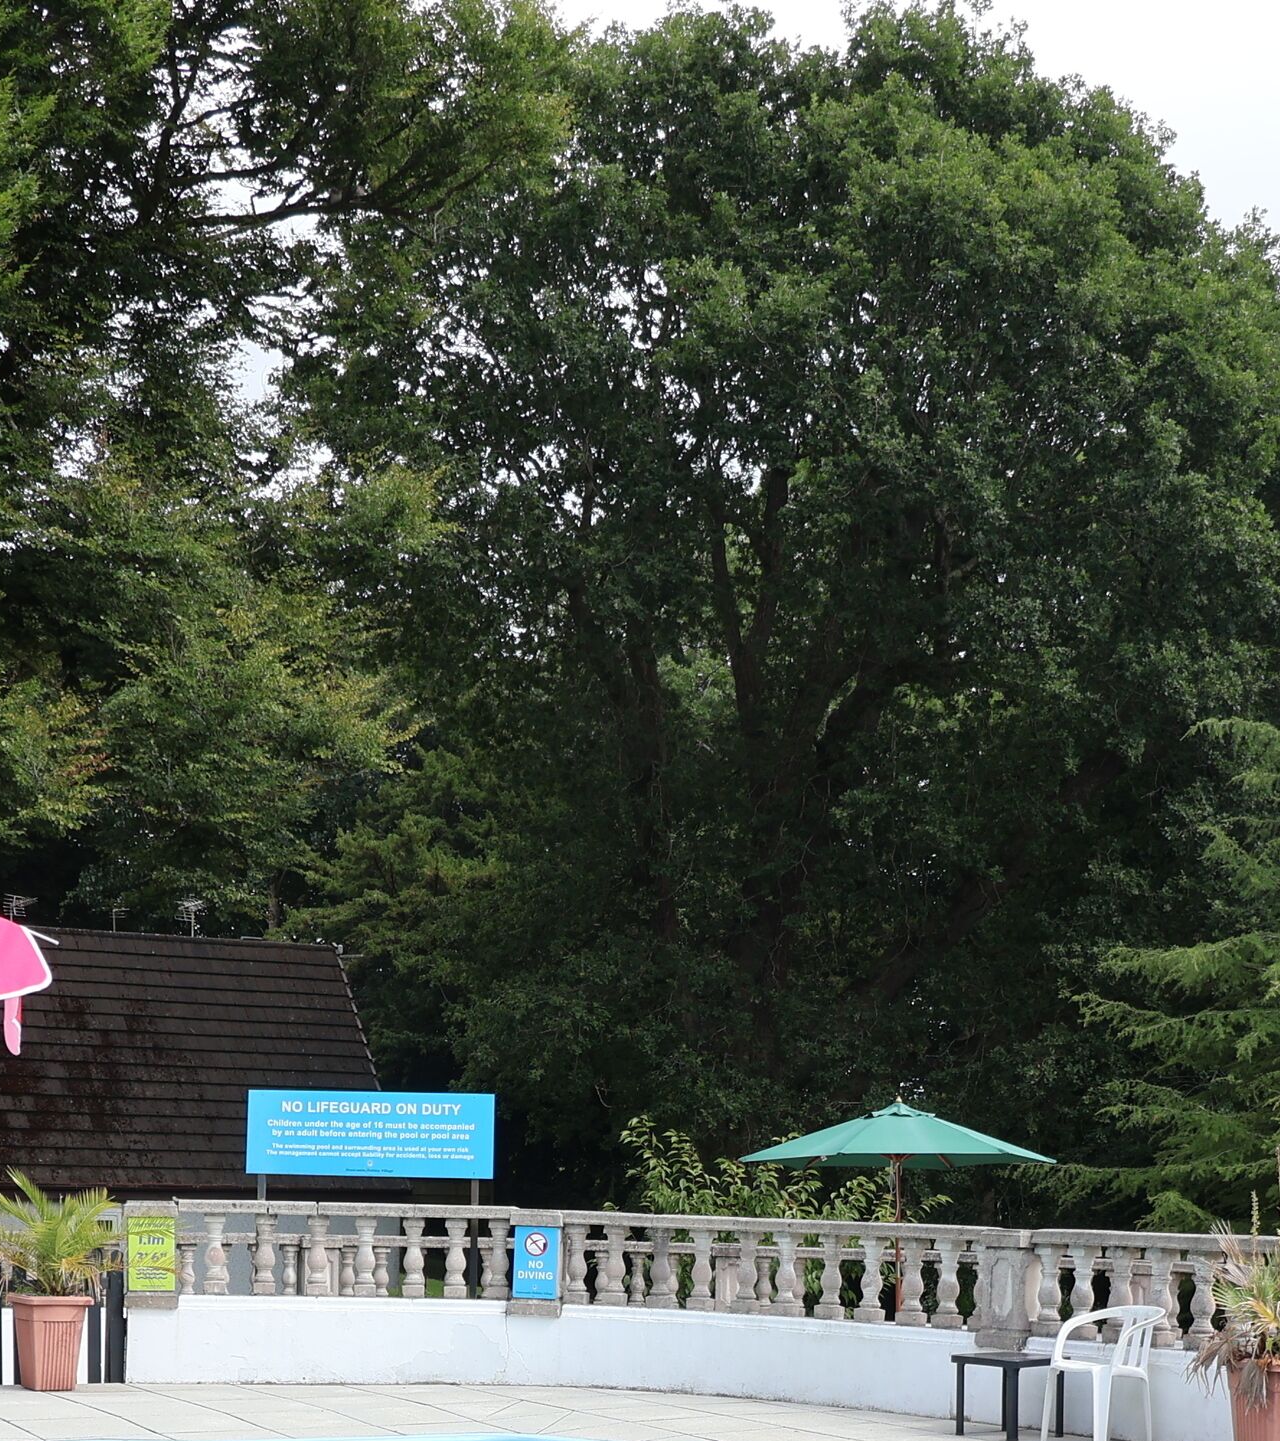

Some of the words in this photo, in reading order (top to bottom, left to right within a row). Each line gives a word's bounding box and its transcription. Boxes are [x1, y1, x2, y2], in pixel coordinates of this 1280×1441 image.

[281, 1101, 303, 1113] NO
[307, 1101, 391, 1115] LIFEGUARD
[396, 1103, 417, 1115] ON
[422, 1103, 461, 1116] DUTY
[267, 1119, 302, 1128] Children
[305, 1120, 328, 1128] under
[331, 1120, 344, 1128] the
[362, 1120, 372, 1128] of
[374, 1121, 383, 1129] 16
[420, 1123, 475, 1131] accompanied
[272, 1129, 281, 1137] by
[297, 1129, 317, 1137] adult
[320, 1129, 346, 1137] before
[348, 1130, 382, 1139] entering
[400, 1131, 418, 1139] pool
[431, 1132, 449, 1140] pool
[528, 1260, 544, 1269] NO
[517, 1270, 553, 1280] DIVING
